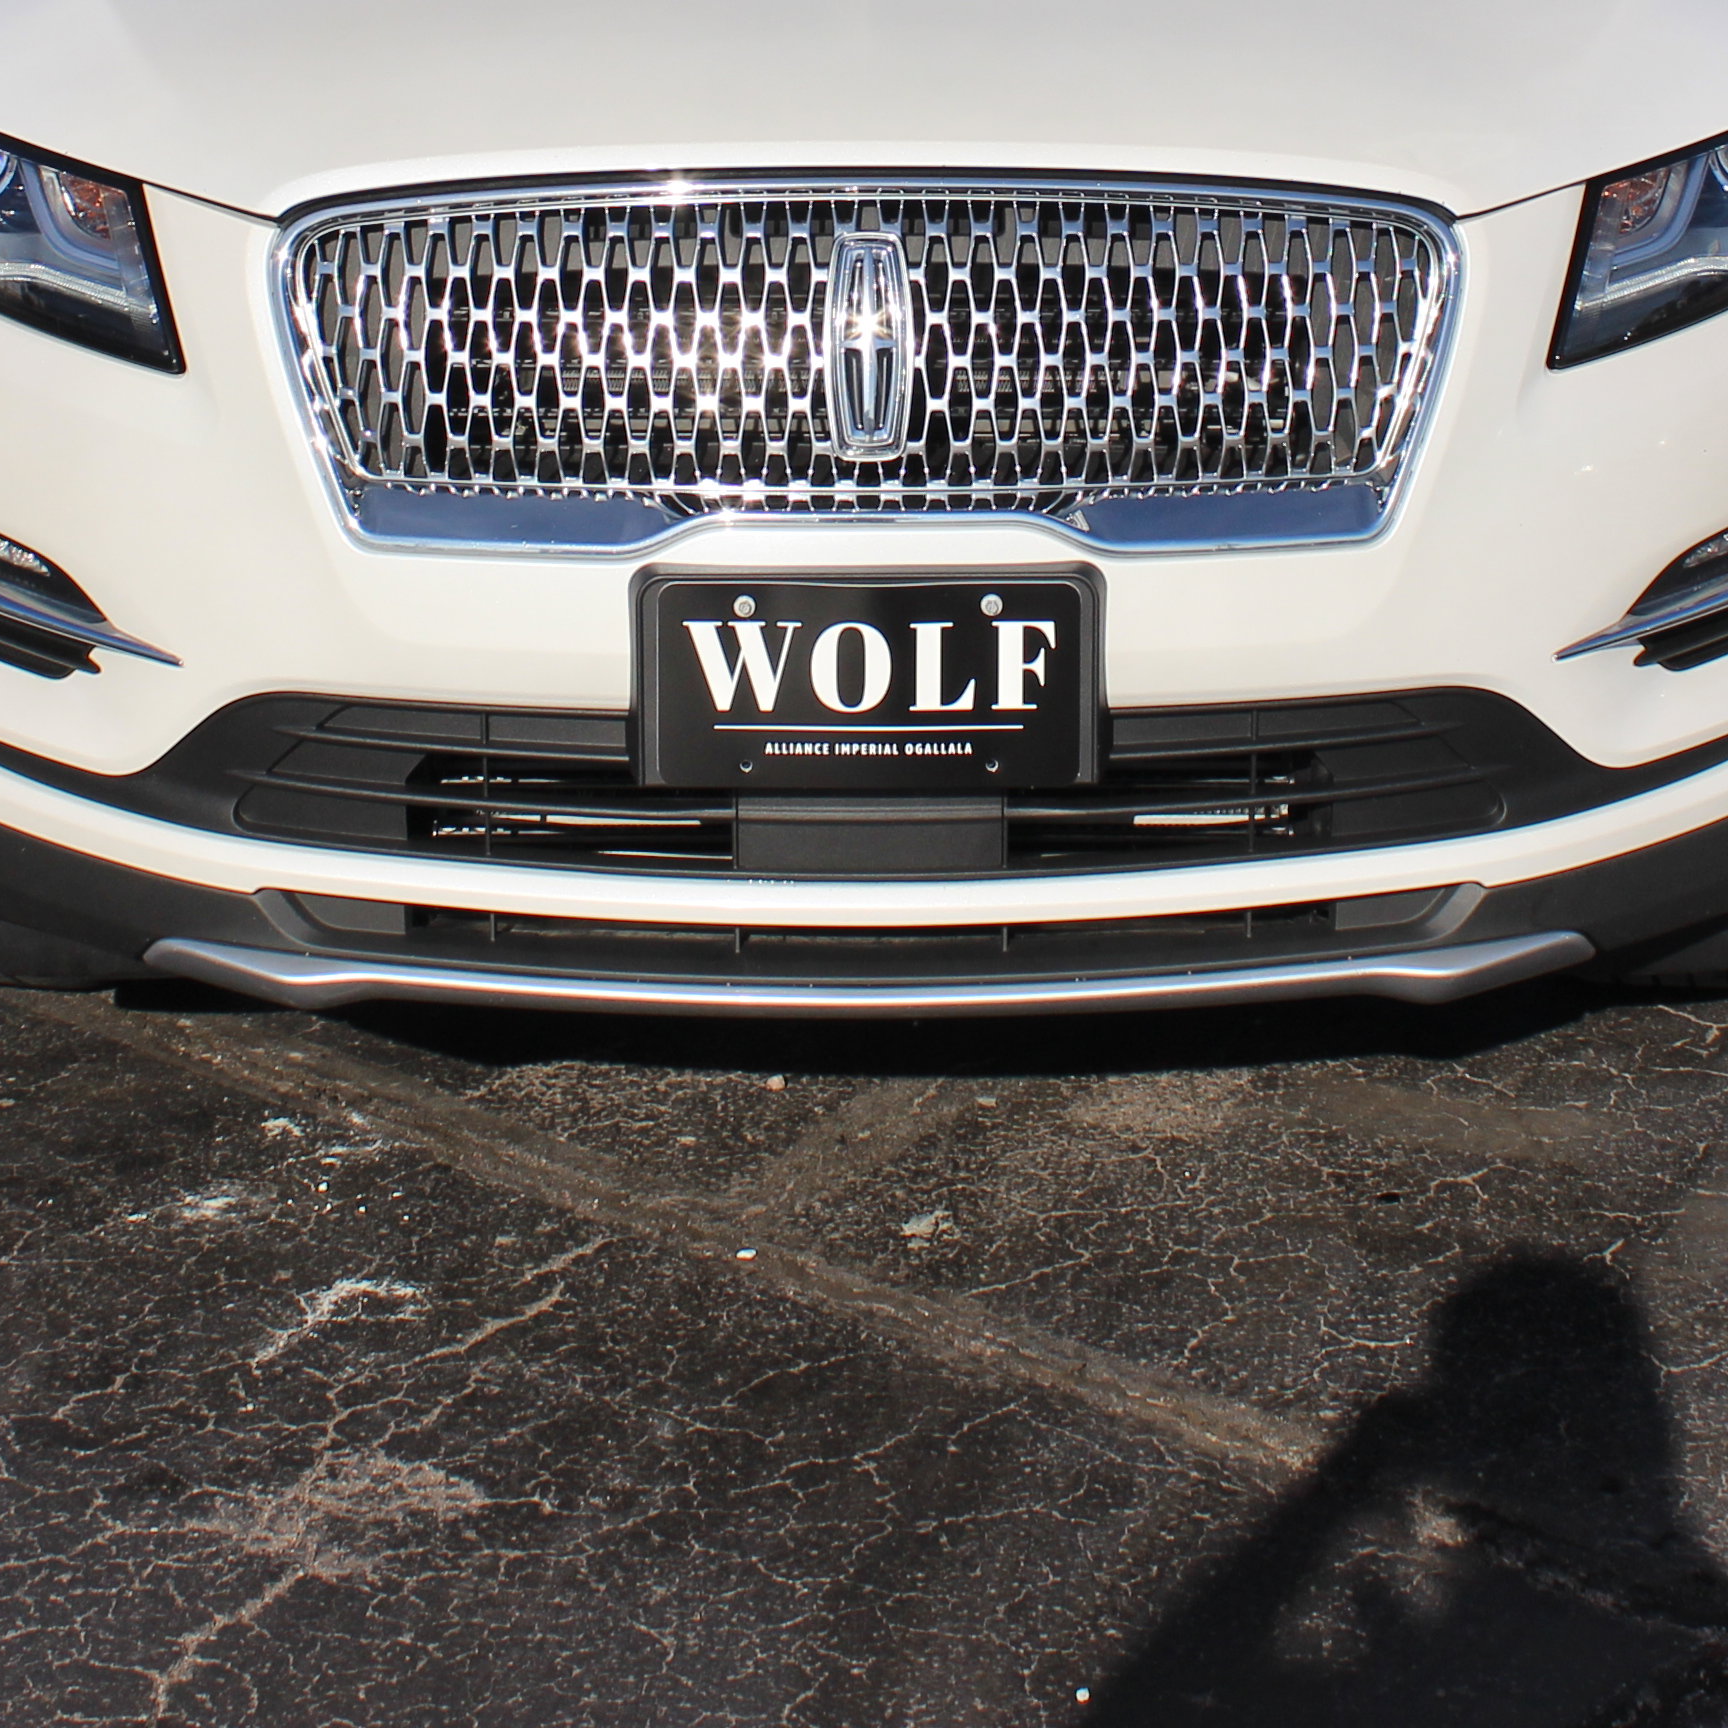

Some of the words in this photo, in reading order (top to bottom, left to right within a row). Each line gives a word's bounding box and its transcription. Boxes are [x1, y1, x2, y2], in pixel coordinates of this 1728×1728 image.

[681, 619, 1057, 714] WOLF
[764, 742, 830, 756] ALLIANCE
[834, 742, 899, 756] IMPERIAL
[903, 742, 973, 756] OGALLALA
